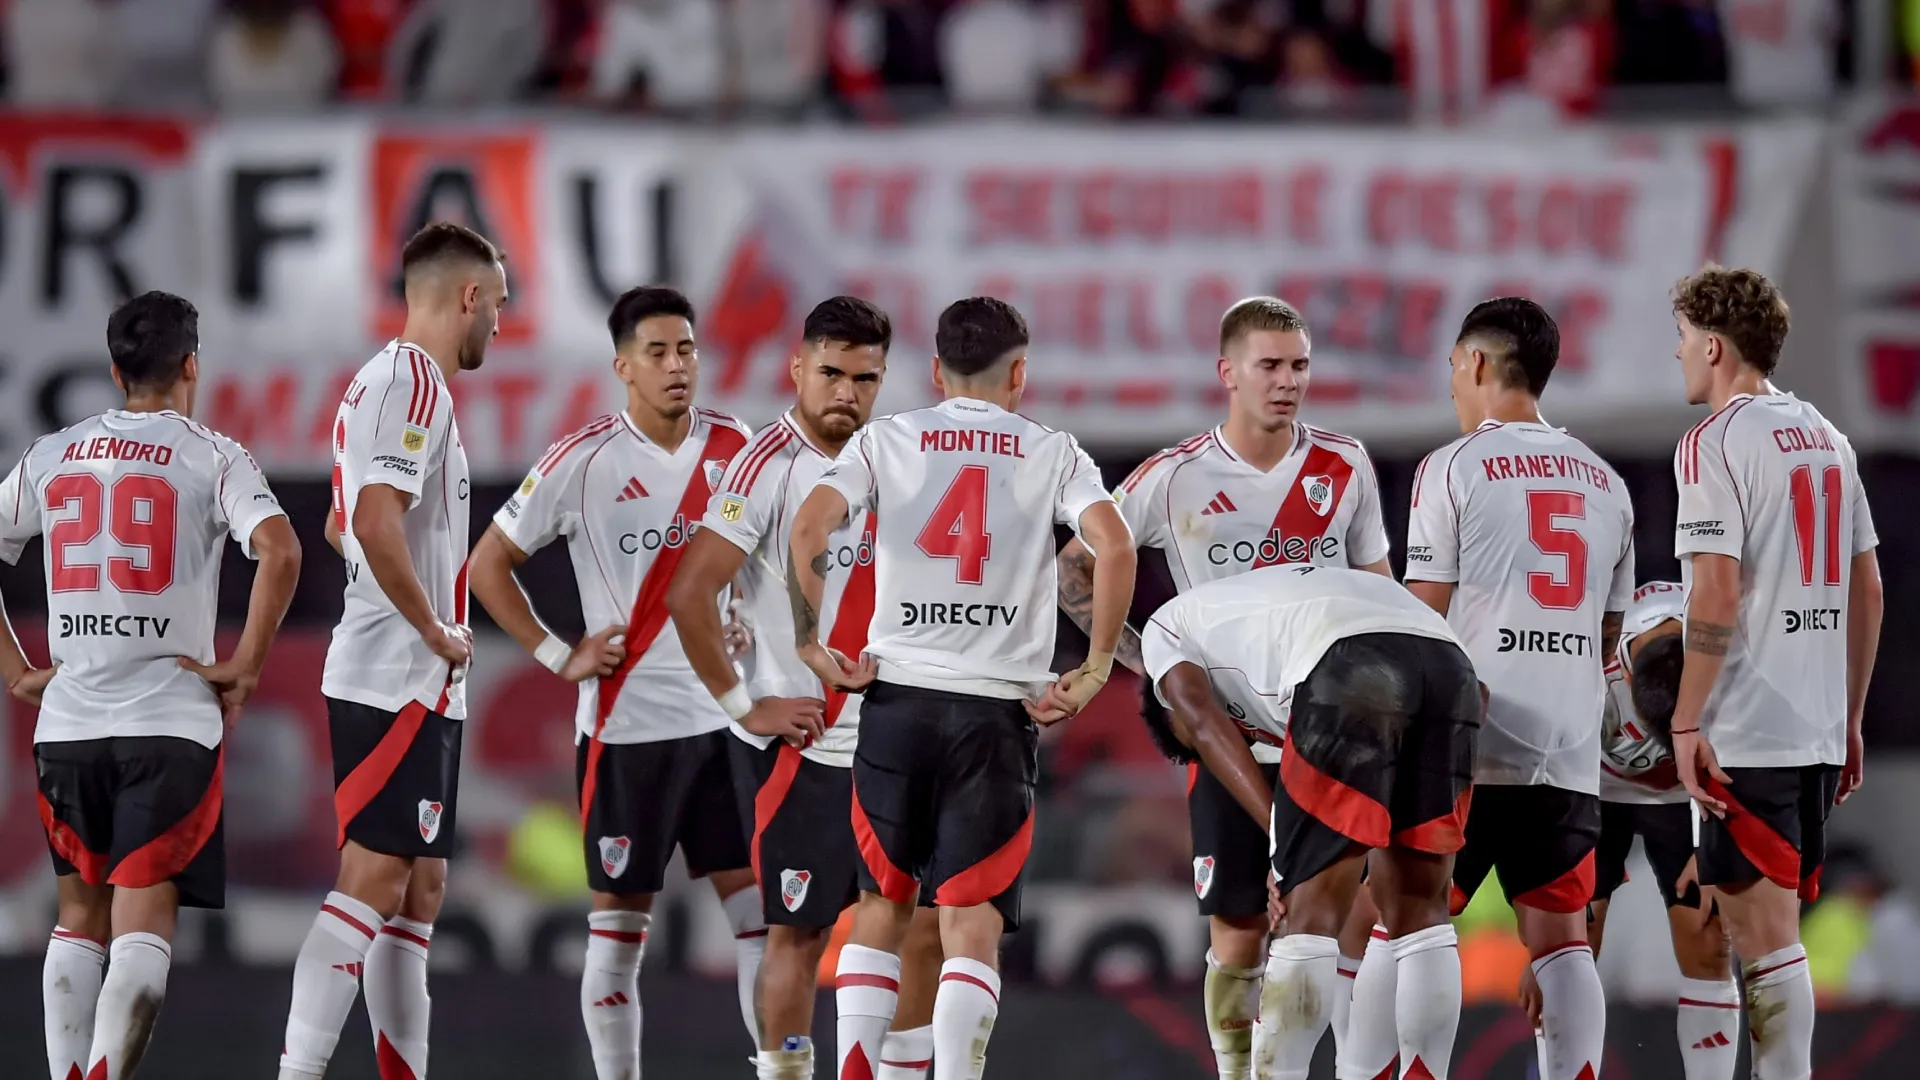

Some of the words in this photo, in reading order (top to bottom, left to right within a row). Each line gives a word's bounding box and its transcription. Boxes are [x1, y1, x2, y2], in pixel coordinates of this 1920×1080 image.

[60, 437, 172, 466] ALIENDRO
[920, 429, 1025, 459] MONTIEL
[372, 455, 418, 467] ASSIST
[383, 462, 418, 476] CARD
[1482, 454, 1612, 494] KRANEVITTER
[44, 472, 178, 595] 29
[915, 464, 992, 586] 4
[1678, 520, 1723, 530] ASSIST
[1690, 528, 1725, 536] CARD
[1790, 463, 1841, 586] 11
[1208, 528, 1339, 566] codere
[1526, 489, 1589, 611] 5
[60, 614, 170, 639] DIRECTV
[900, 602, 1018, 627] DIRECTV
